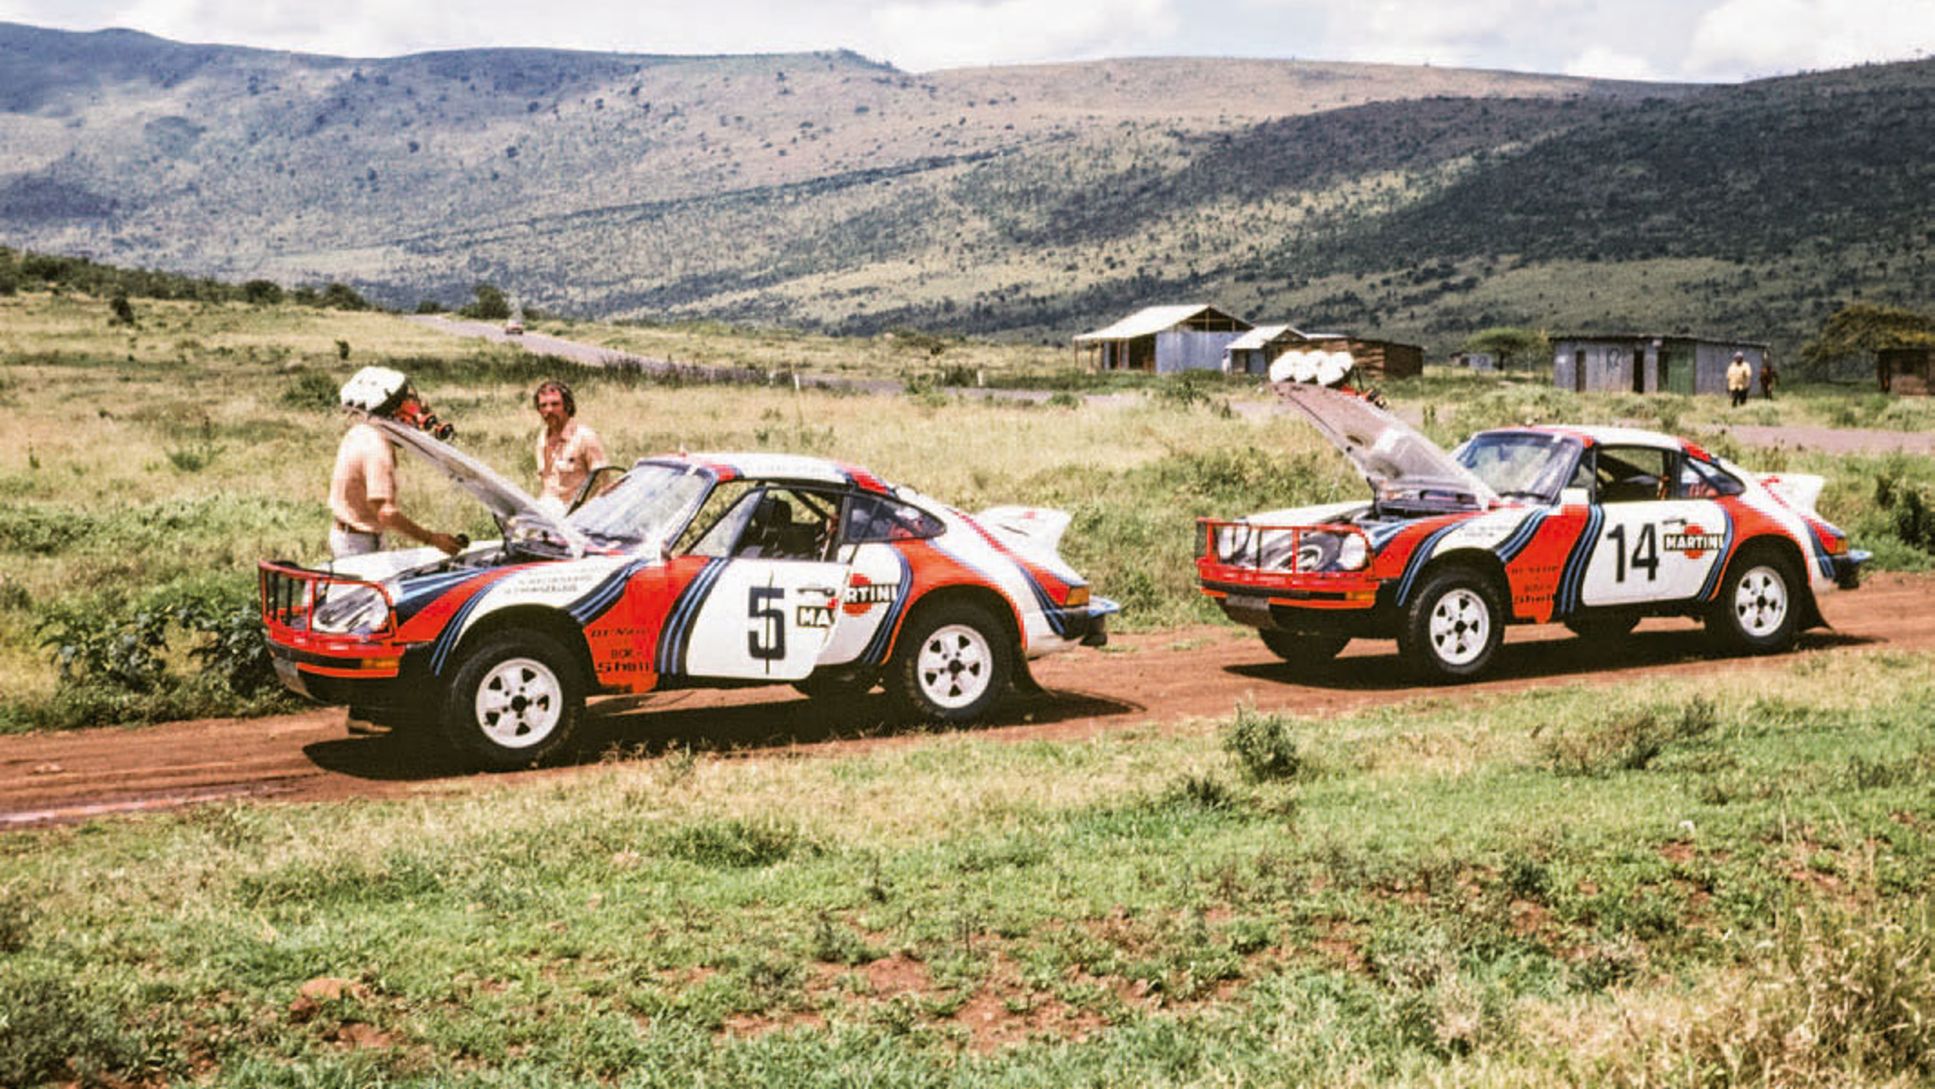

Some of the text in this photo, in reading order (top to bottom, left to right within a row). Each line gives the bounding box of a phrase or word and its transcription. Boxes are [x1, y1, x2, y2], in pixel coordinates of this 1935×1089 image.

[1606, 523, 1660, 582] 14
[1664, 534, 1724, 550] MARTINI
[748, 586, 785, 660] 5
